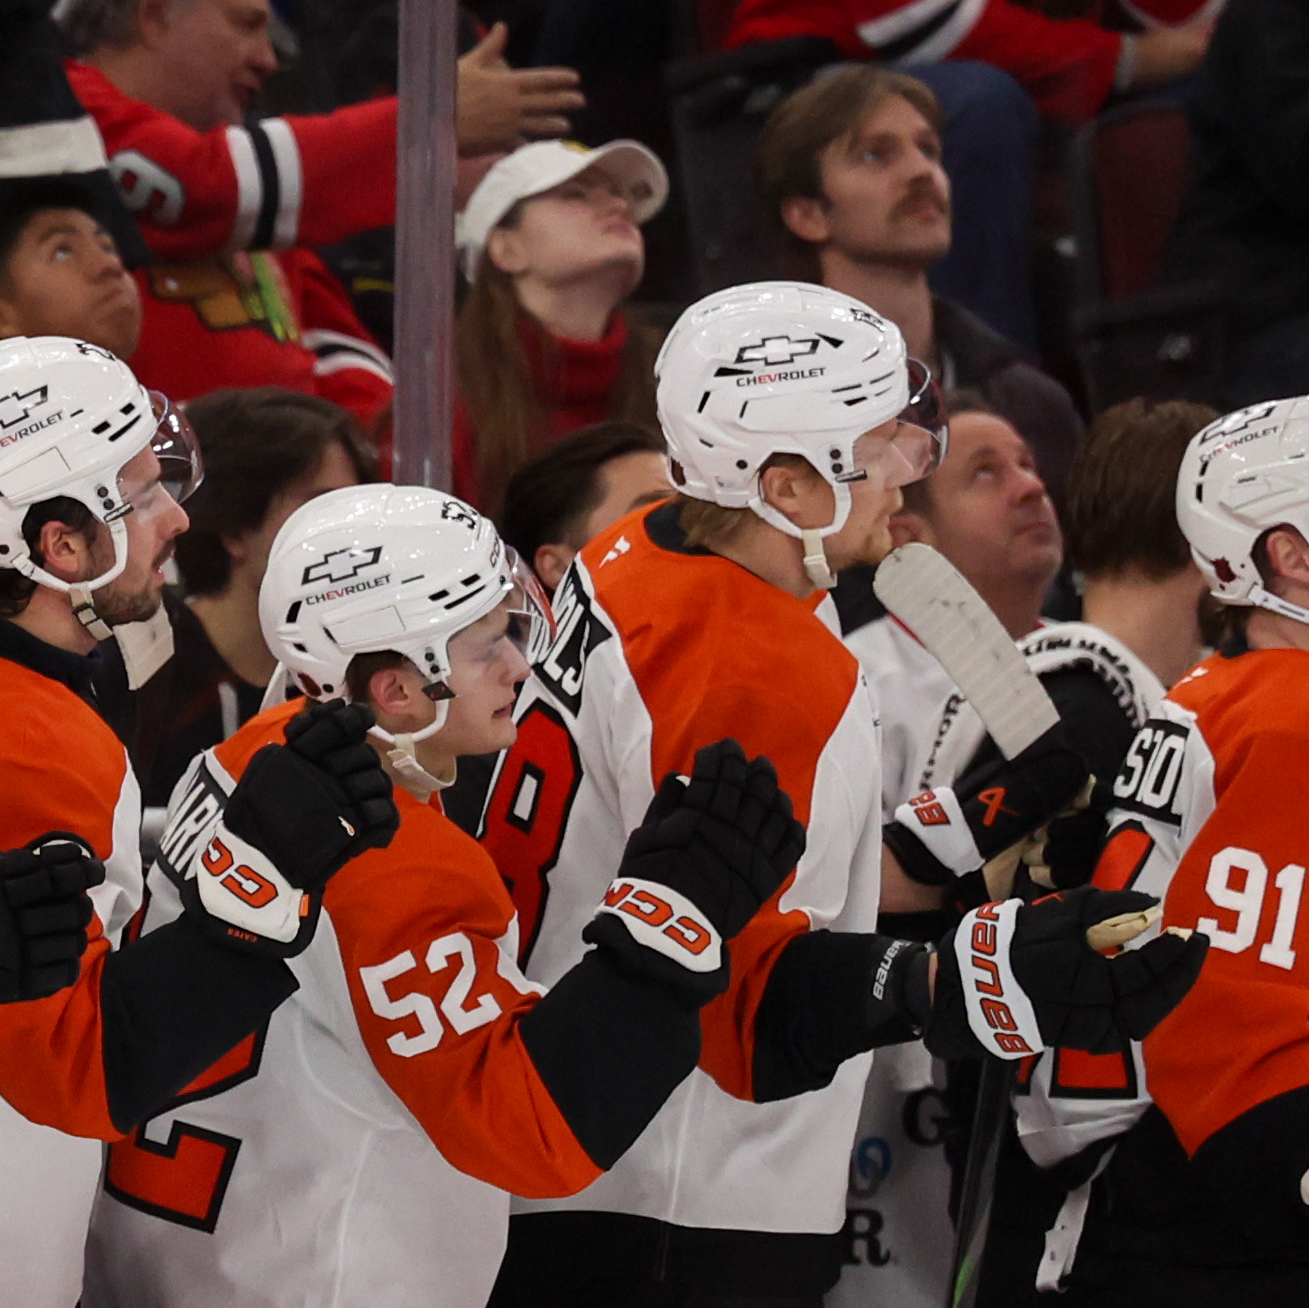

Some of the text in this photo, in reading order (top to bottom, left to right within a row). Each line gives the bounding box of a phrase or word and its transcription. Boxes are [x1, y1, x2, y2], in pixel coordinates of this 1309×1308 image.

[736, 367, 826, 388] CHEVROLET
[305, 573, 391, 606] CHEVROLET
[1196, 846, 1306, 971] 91
[359, 931, 503, 1058] 52
